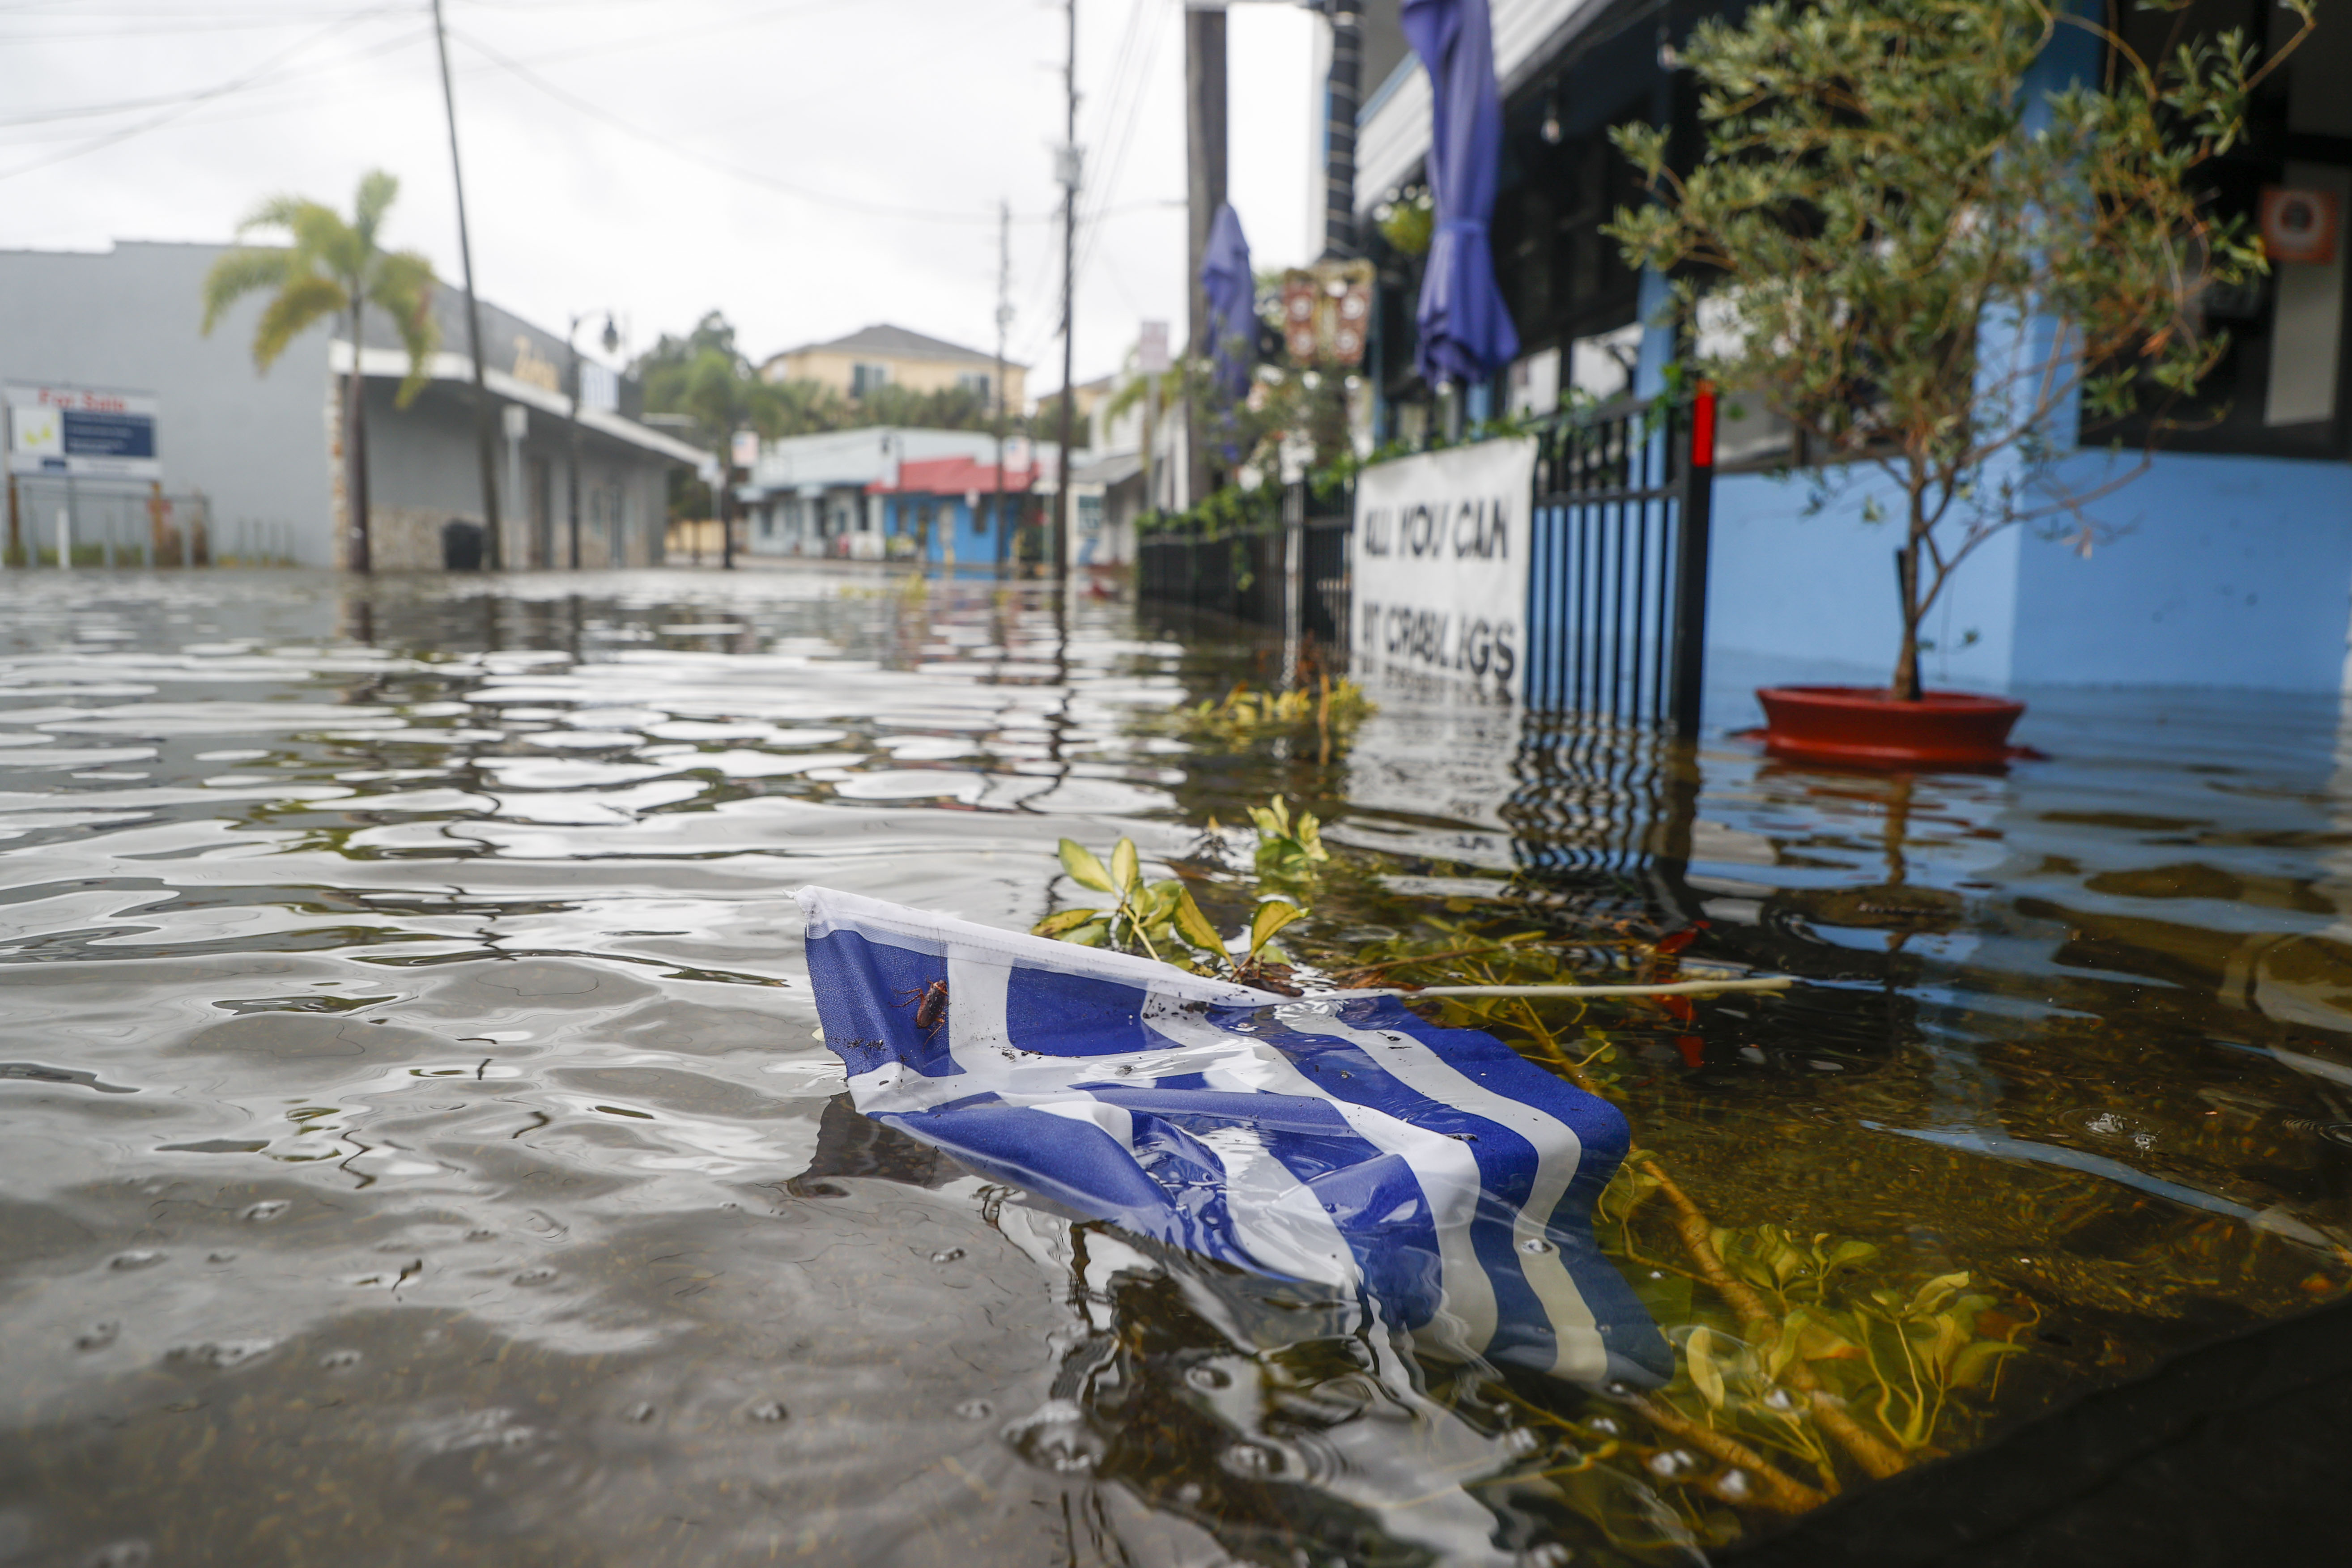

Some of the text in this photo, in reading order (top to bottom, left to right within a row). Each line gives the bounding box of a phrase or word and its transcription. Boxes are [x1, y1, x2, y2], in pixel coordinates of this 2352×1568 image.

[38, 387, 127, 412] For Sale
[1399, 503, 1451, 557] YOU
[1454, 497, 1510, 559] CAN
